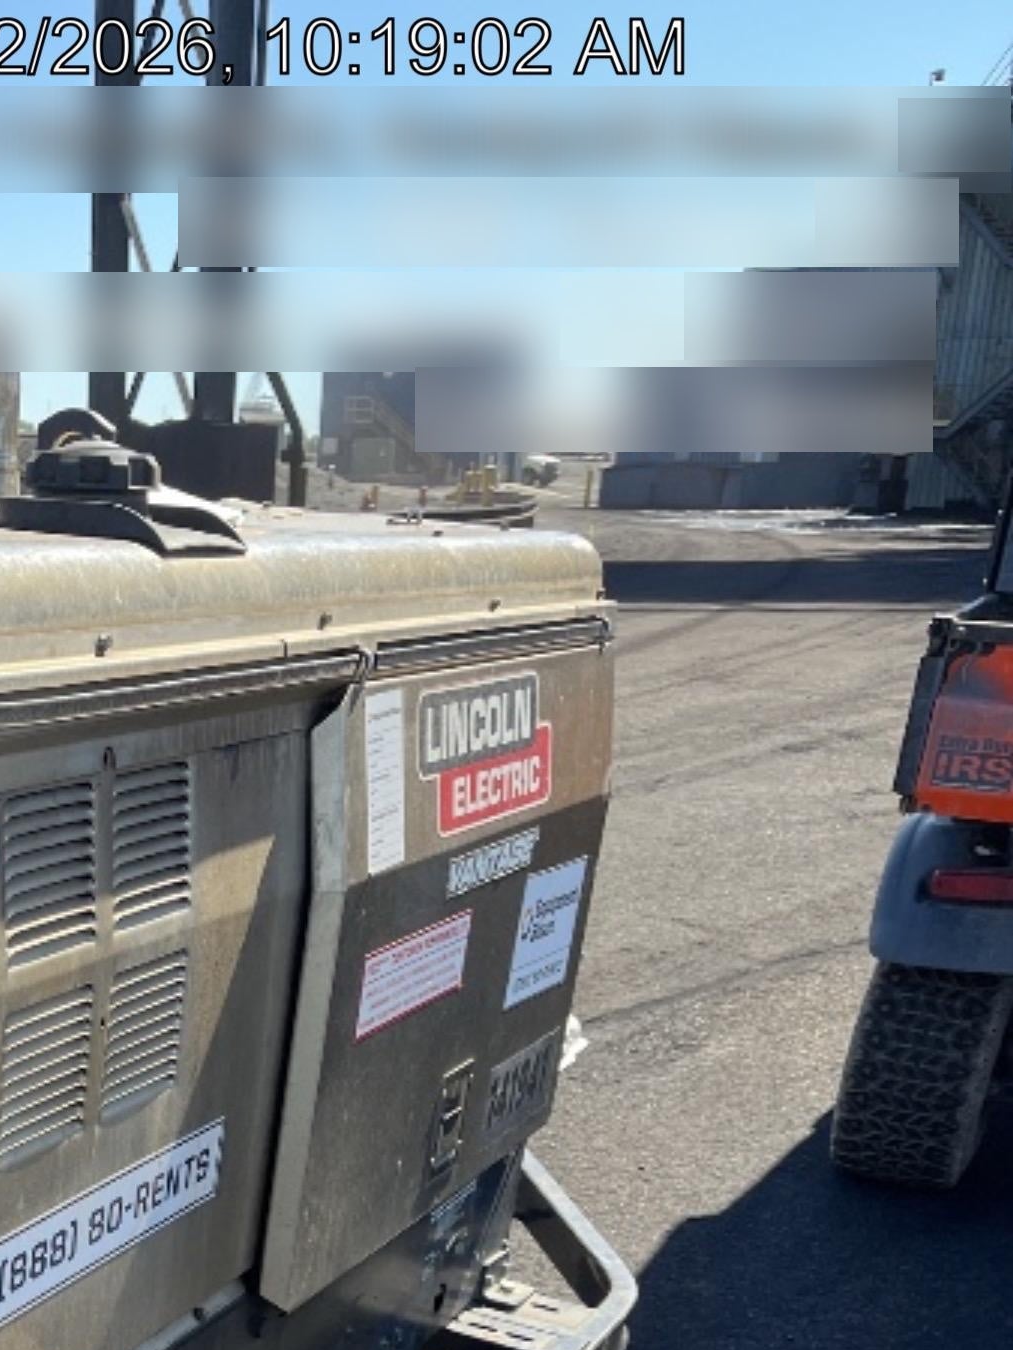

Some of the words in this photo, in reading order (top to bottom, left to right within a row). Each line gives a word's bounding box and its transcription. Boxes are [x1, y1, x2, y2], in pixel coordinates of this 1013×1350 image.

[426, 686, 532, 764] LINCOLN
[451, 755, 541, 819] ELECTRIC
[87, 1149, 211, 1248] 80-RENTS
